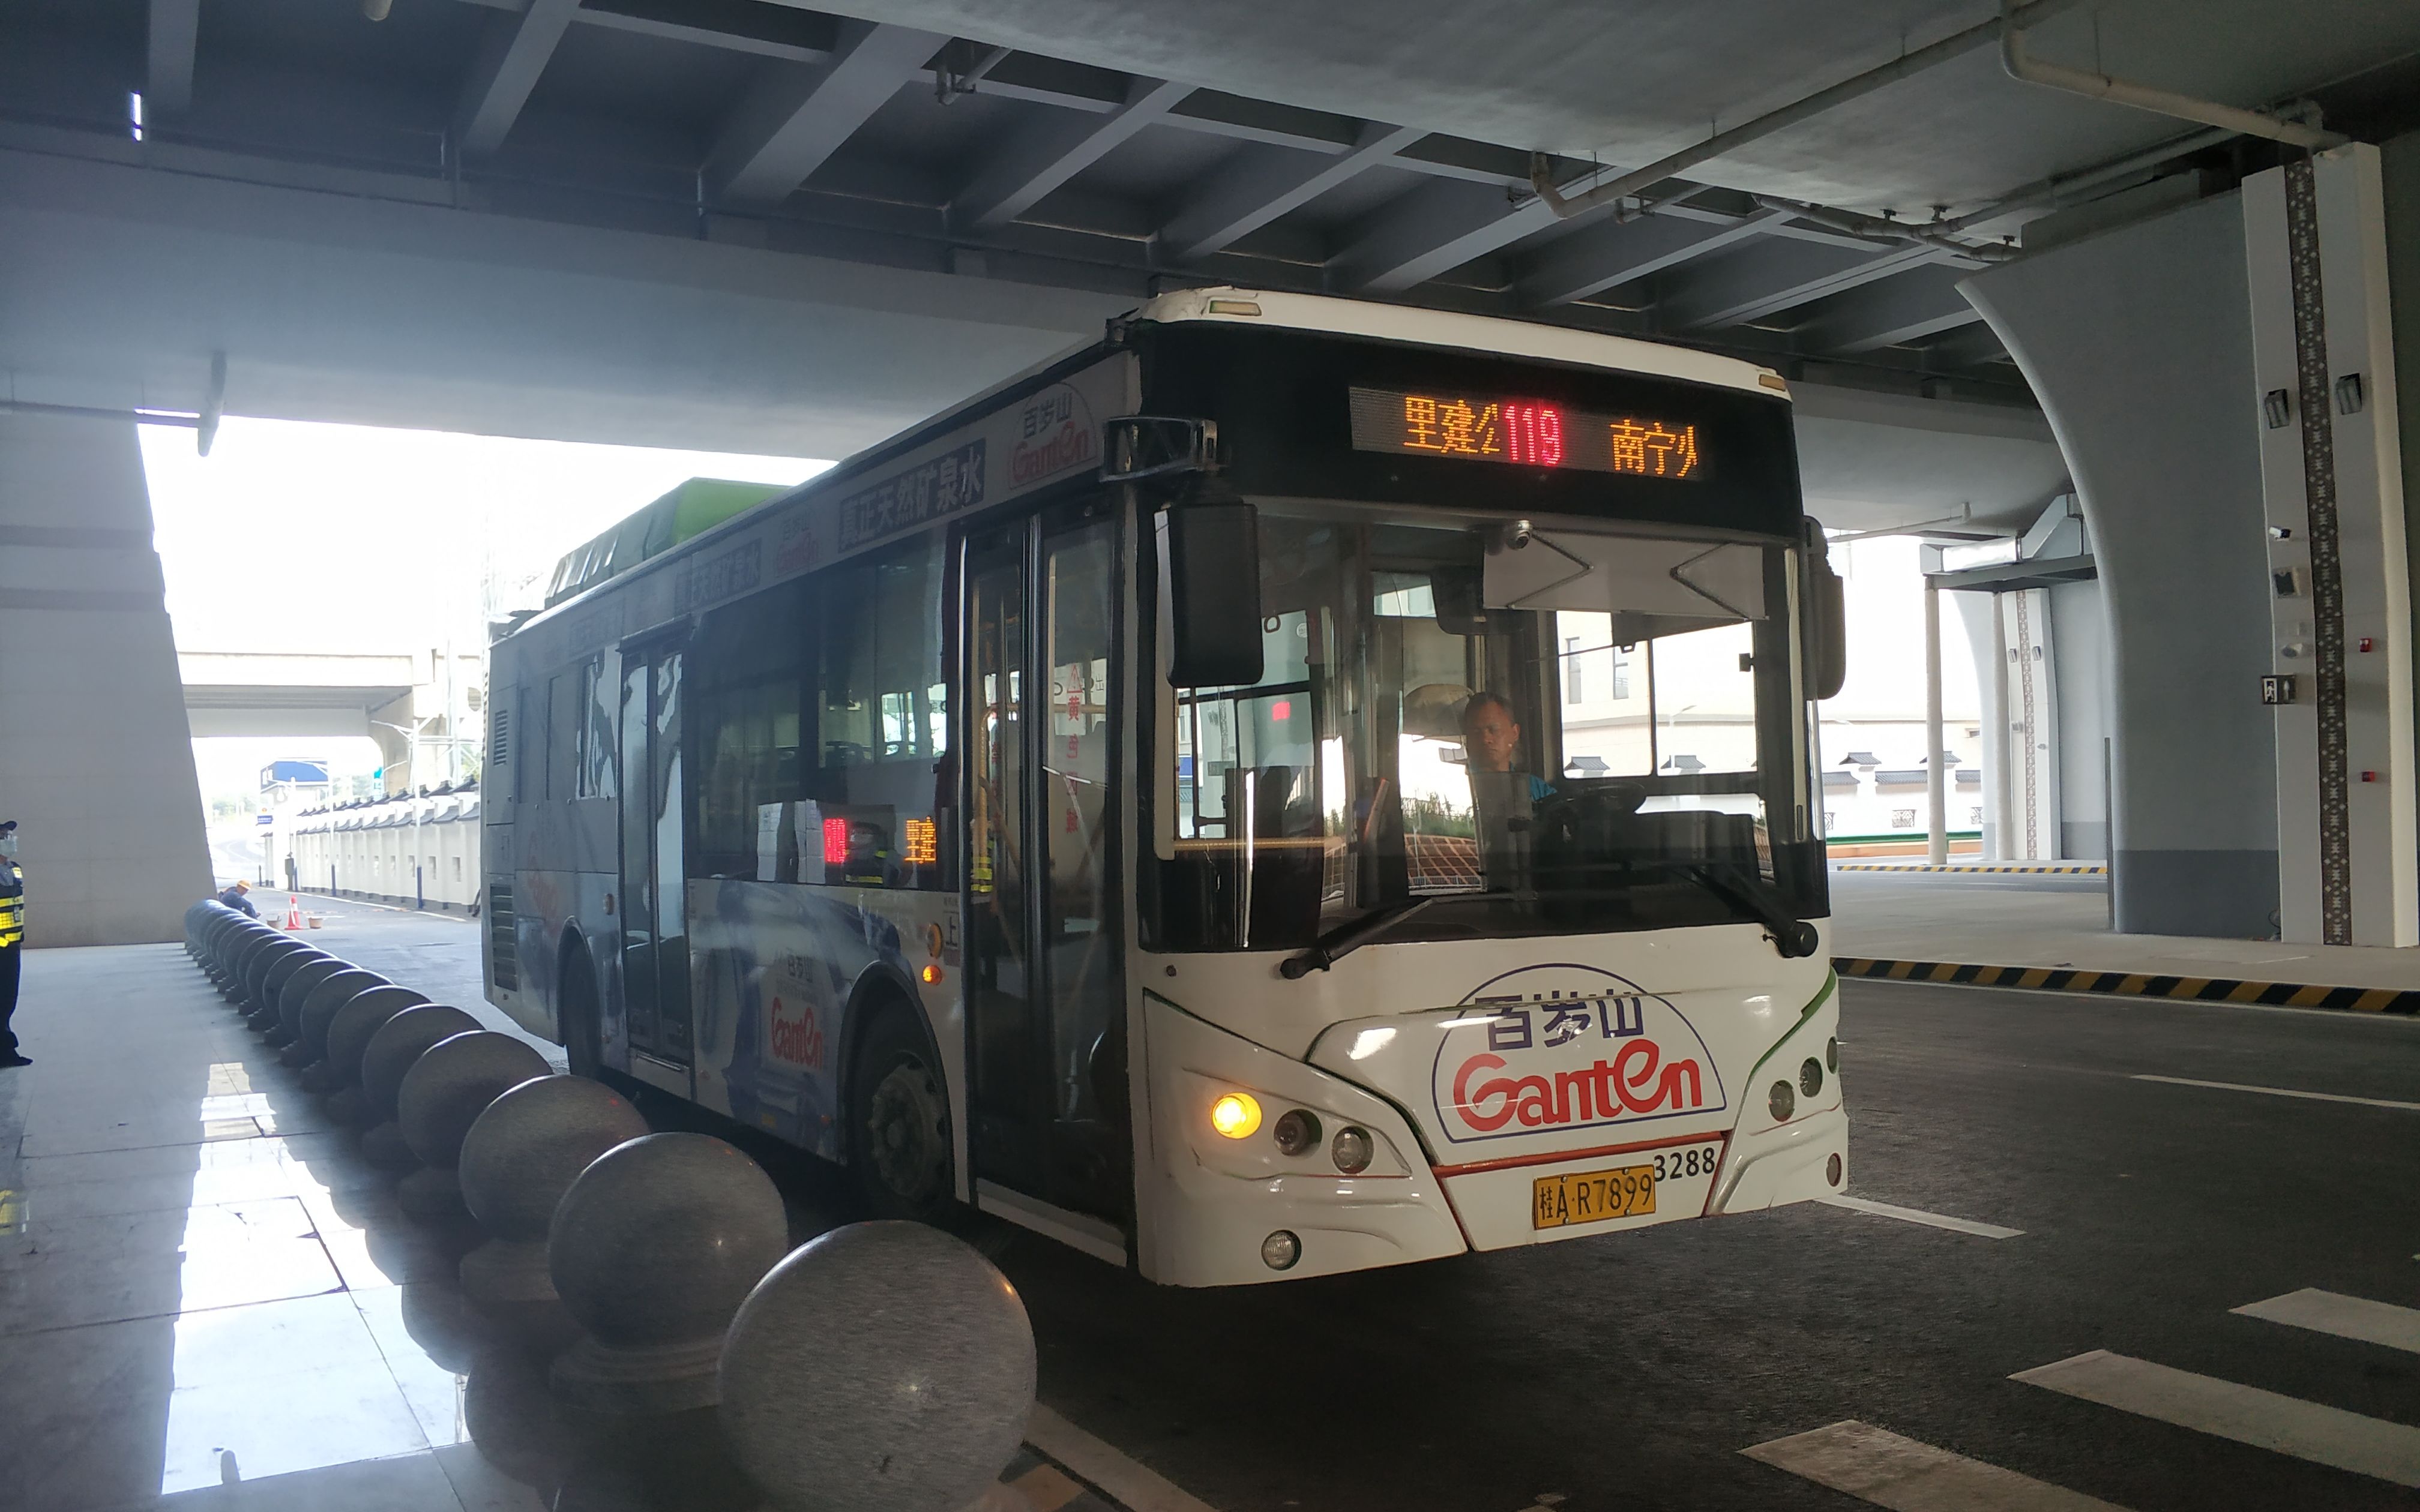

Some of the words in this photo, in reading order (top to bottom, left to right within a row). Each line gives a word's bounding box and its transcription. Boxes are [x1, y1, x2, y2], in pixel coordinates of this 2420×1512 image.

[1023, 392, 1073, 440] 百岁山
[1505, 405, 1561, 464] 119
[1011, 421, 1089, 482] Ganten
[1475, 989, 1644, 1051] 百岁山
[1453, 1039, 1702, 1132] Ganten
[1654, 1147, 1715, 1183] 3288
